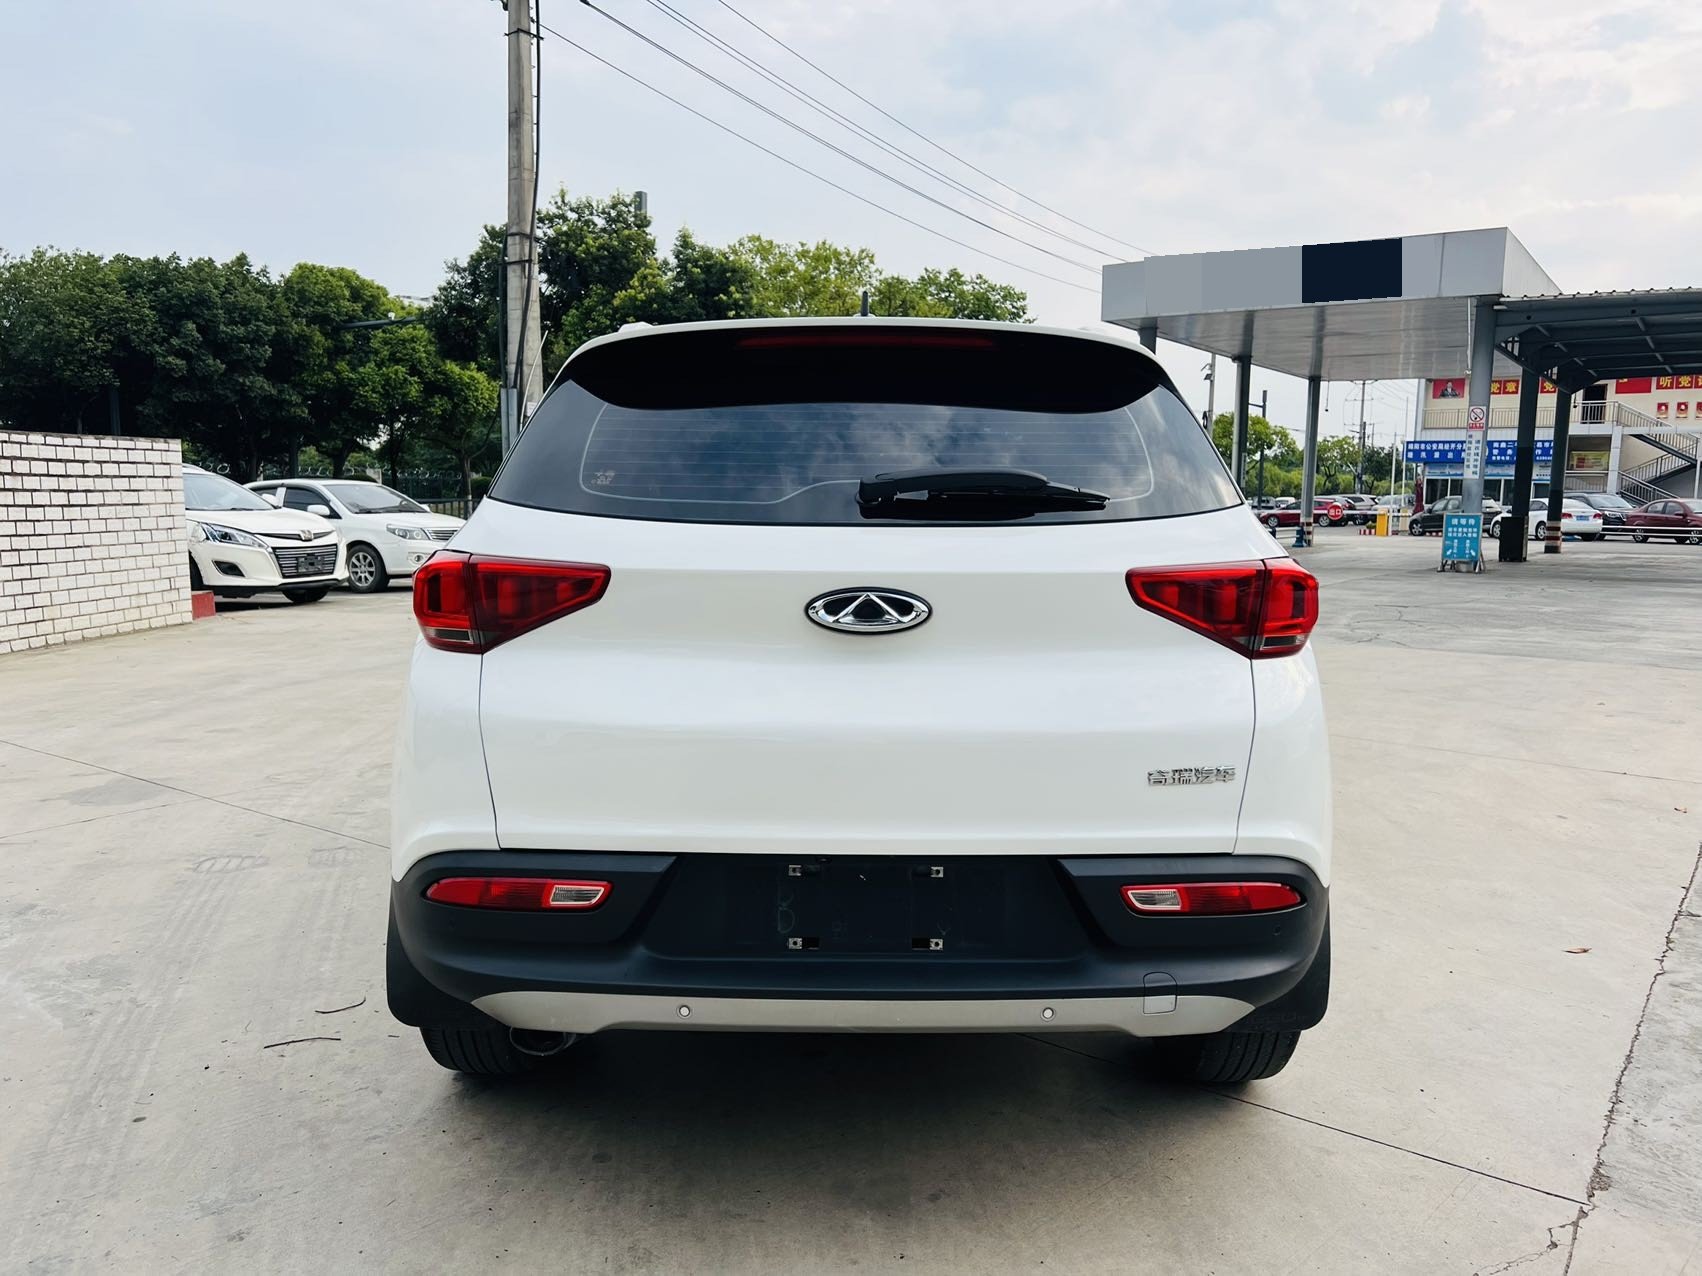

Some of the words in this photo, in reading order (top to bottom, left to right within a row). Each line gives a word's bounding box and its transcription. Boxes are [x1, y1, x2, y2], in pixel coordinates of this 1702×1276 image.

[1329, 508, 1342, 516] 出口
[1147, 766, 1236, 786] 奇瑞汽车
